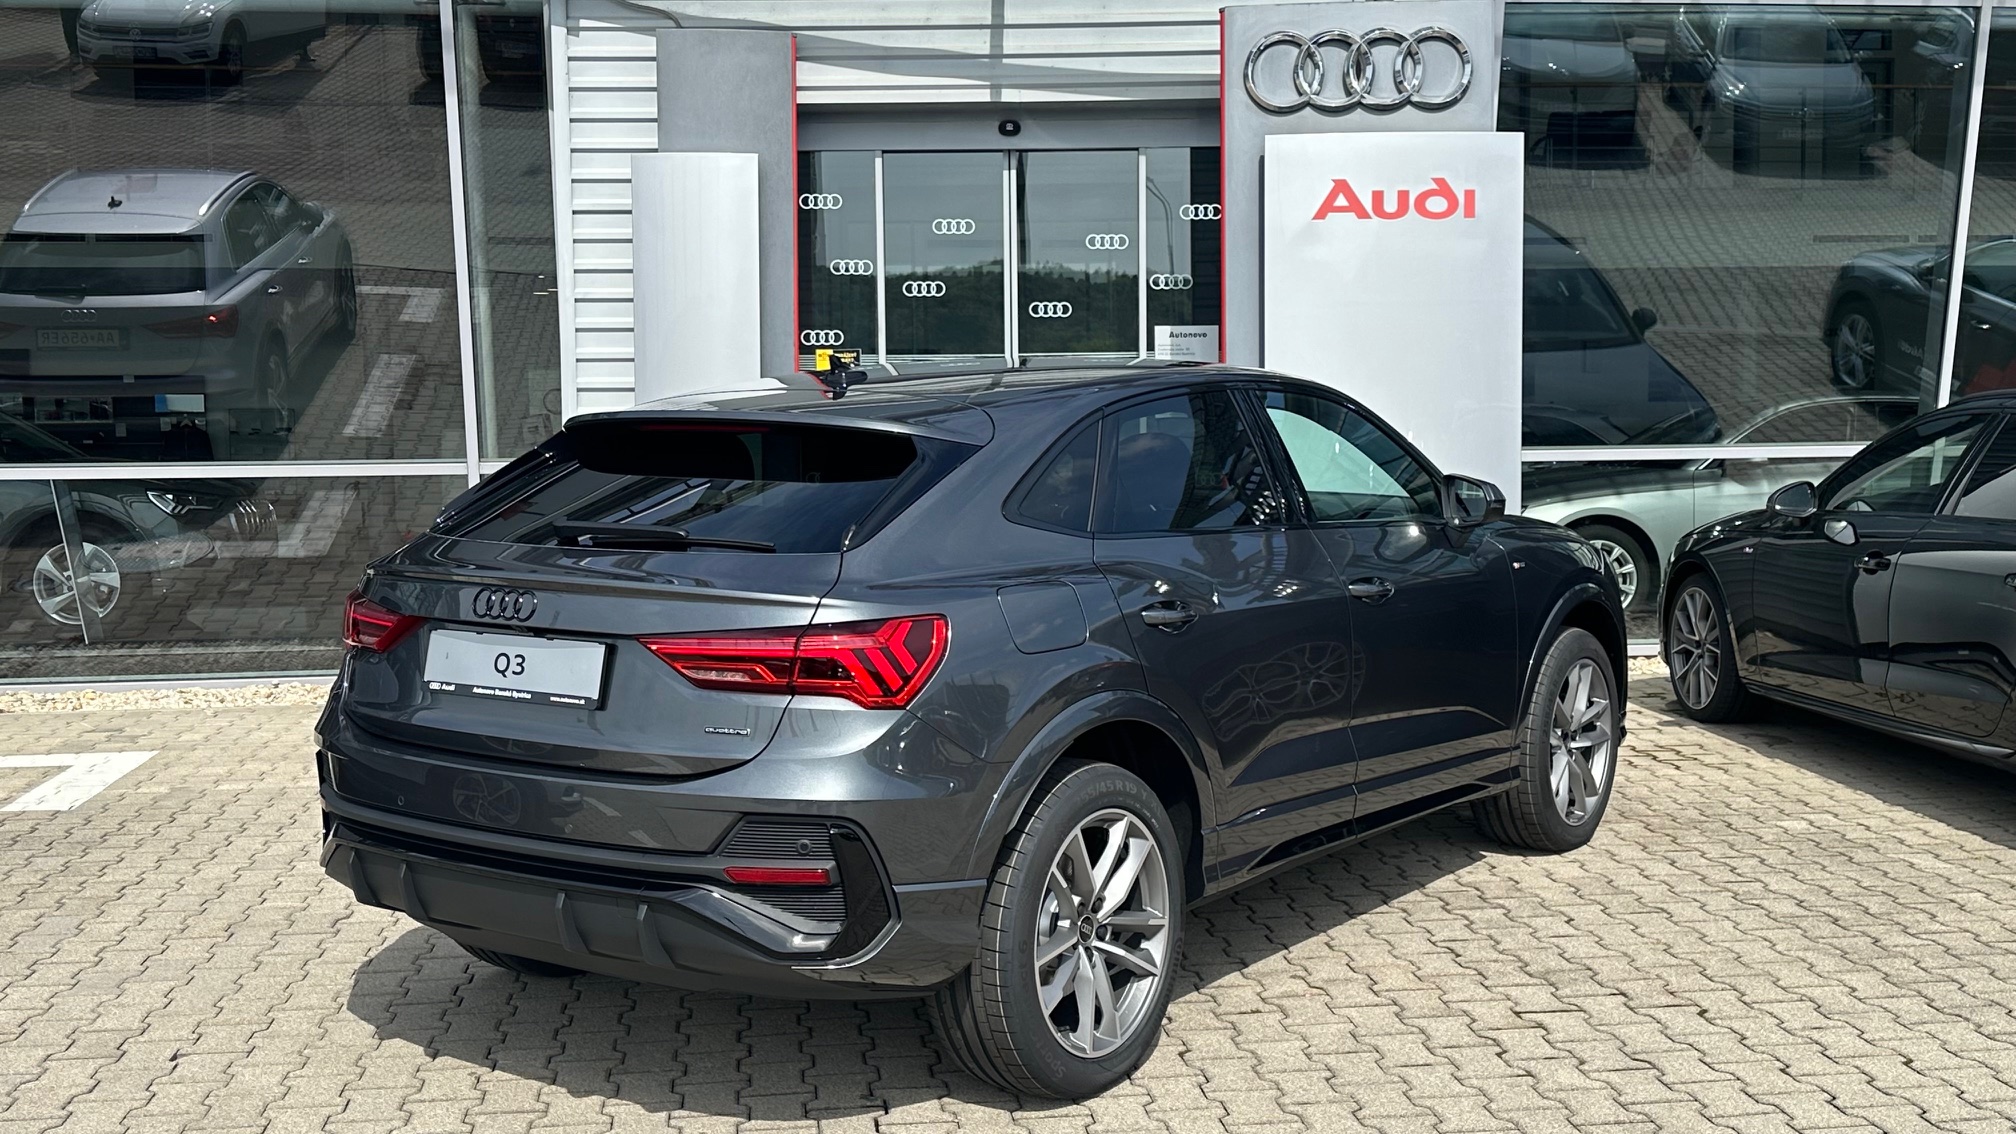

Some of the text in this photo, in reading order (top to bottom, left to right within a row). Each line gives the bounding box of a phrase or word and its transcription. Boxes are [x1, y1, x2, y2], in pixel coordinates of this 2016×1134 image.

[1312, 177, 1476, 220] Audi
[1169, 331, 1208, 339] Autonovo
[493, 652, 526, 678] Q3
[441, 683, 456, 691] Audi
[705, 727, 749, 736] quattro
